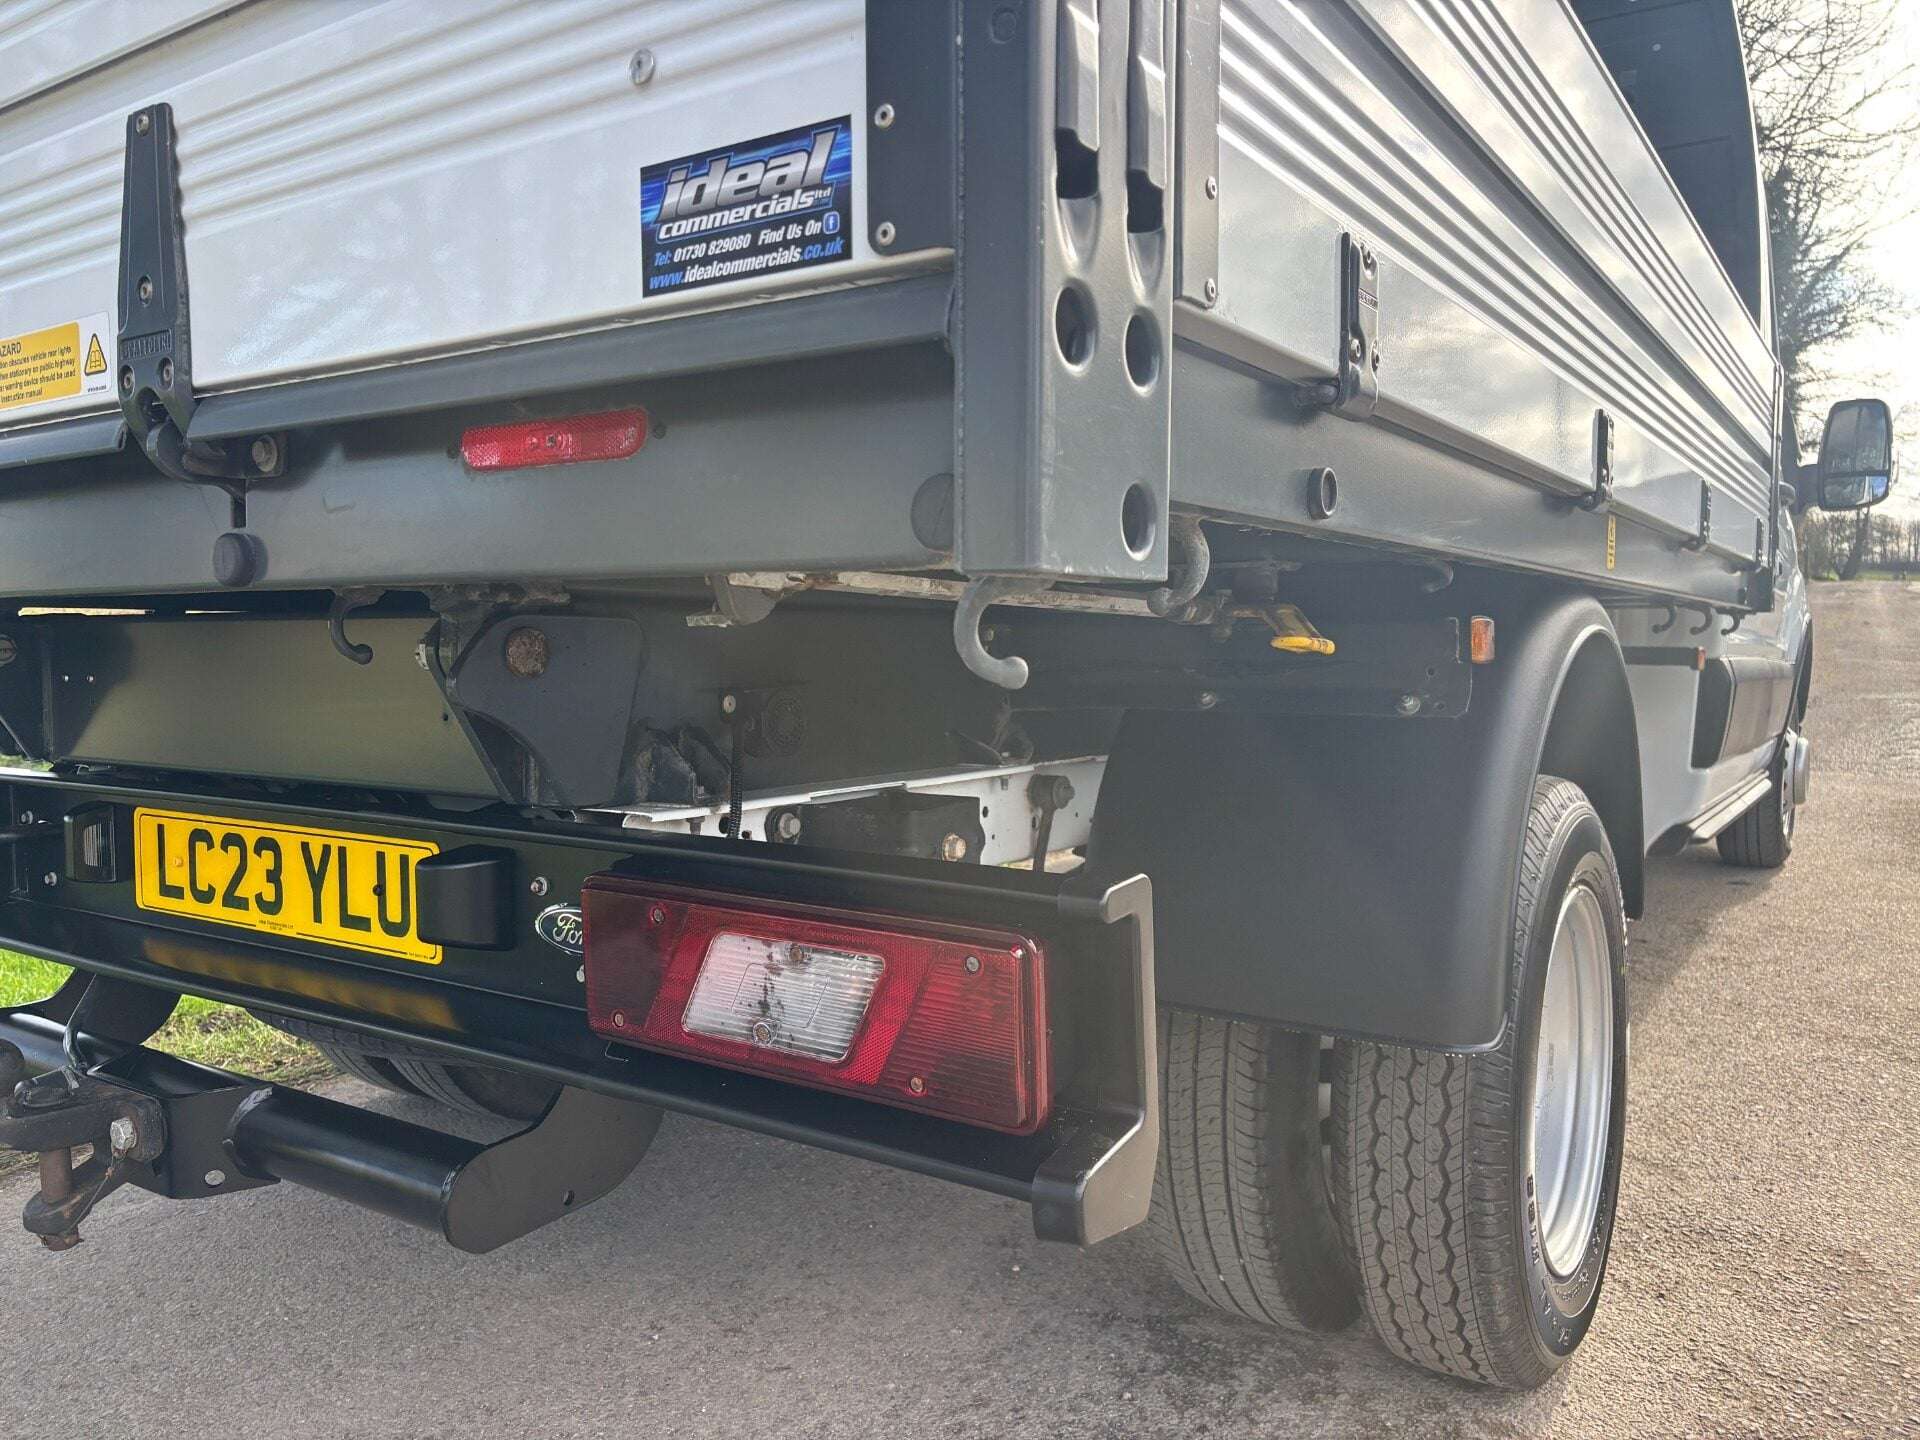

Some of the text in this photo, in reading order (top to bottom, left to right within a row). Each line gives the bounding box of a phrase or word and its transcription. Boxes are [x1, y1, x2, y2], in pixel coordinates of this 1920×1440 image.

[657, 127, 840, 221] ideal
[659, 188, 816, 239] commercials
[649, 236, 845, 290] www.idealcommercials.co.uk
[655, 250, 672, 266] Tel:
[673, 242, 707, 262] 01730
[708, 233, 752, 256] 829080
[758, 226, 785, 245] Find
[787, 223, 803, 240] Us
[805, 219, 822, 236] On
[9, 367, 31, 378] stationary
[40, 362, 54, 373] public
[55, 358, 75, 370] highway
[31, 351, 47, 362] vehicle
[48, 349, 57, 357] rear
[58, 345, 71, 356] lights
[5, 381, 23, 391] warning
[24, 377, 38, 387] device
[40, 373, 55, 384] should
[57, 371, 63, 380] be
[64, 368, 75, 378] used
[157, 823, 411, 937] LC23 YLU
[553, 913, 582, 945] For
